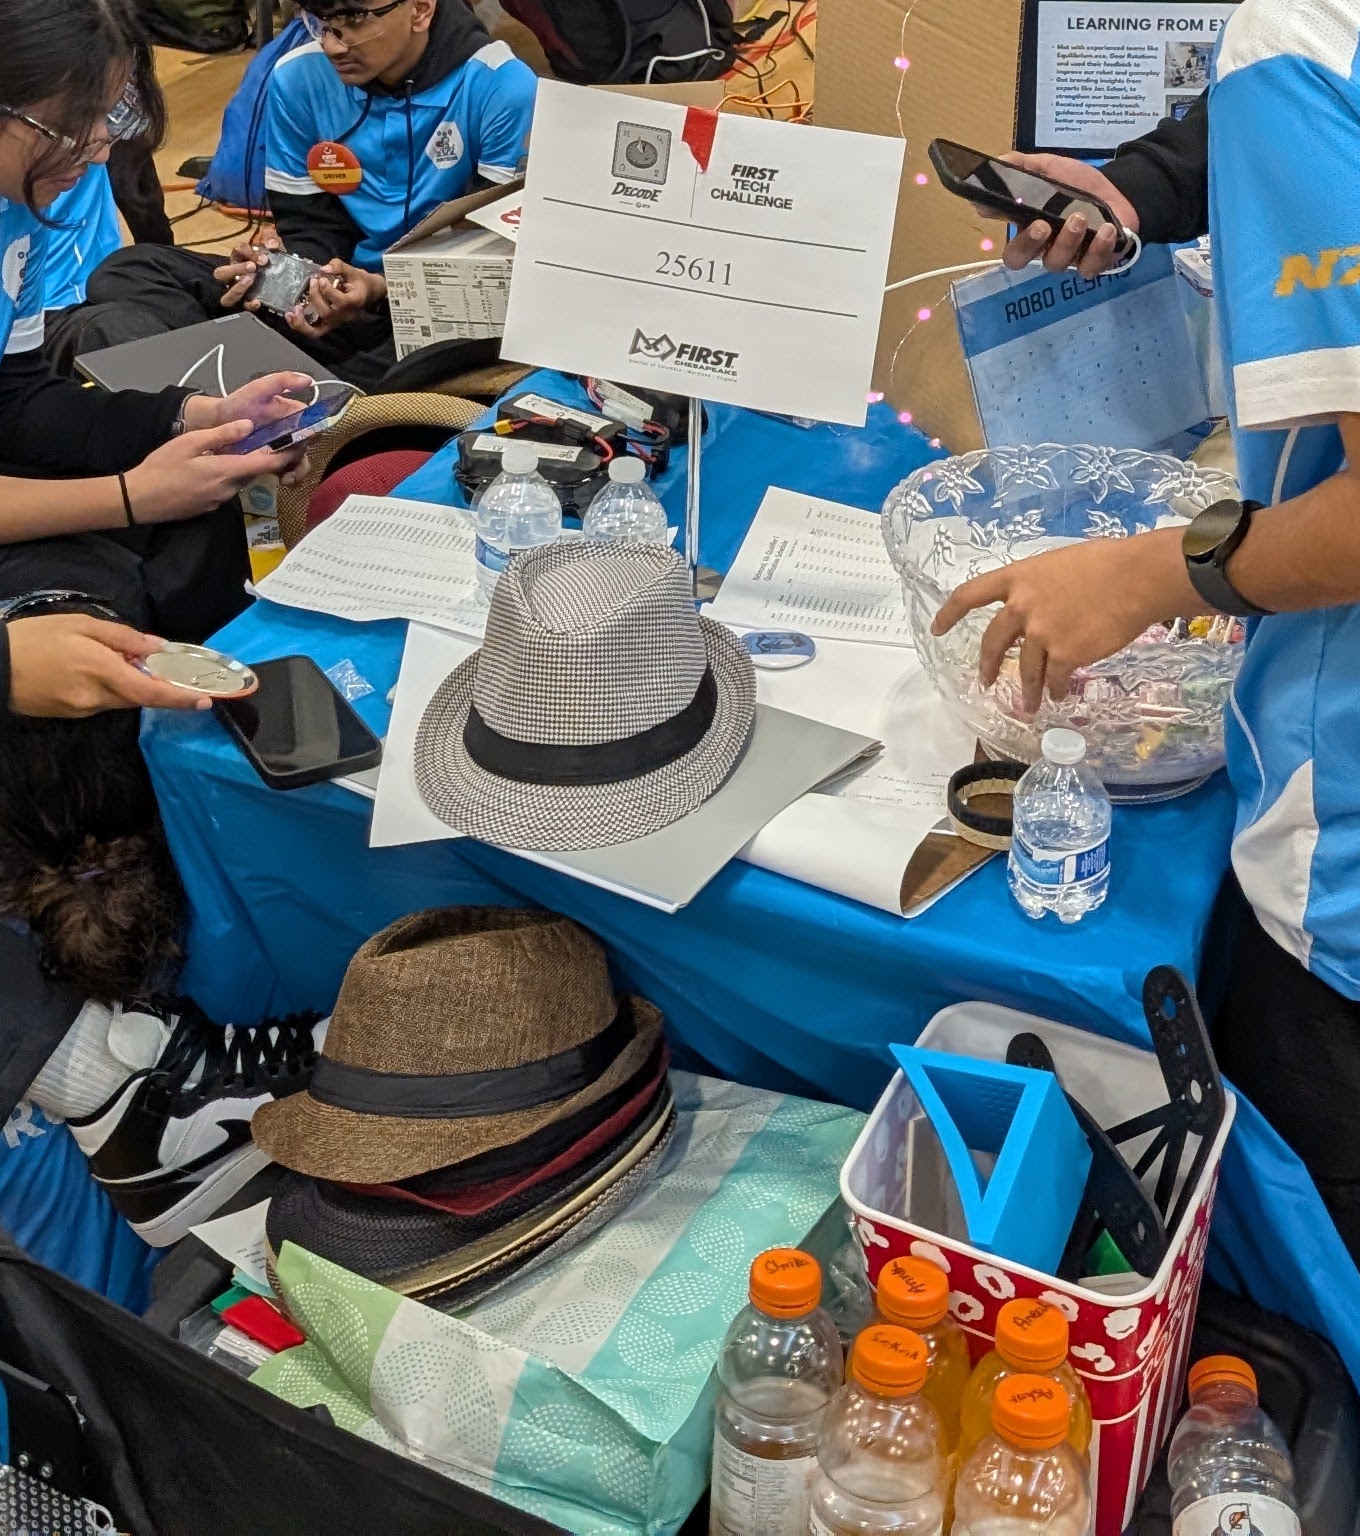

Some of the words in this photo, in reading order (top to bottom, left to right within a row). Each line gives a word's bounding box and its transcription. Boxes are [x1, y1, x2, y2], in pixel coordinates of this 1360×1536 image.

[1067, 17, 1151, 30] LEARNING
[1157, 18, 1203, 31] FROM
[731, 164, 779, 181] FIRST
[611, 182, 662, 202] DECODE
[733, 178, 770, 193] TECH
[711, 188, 793, 210] CHALLENGE
[655, 251, 733, 286] 25611
[1005, 287, 1055, 323] ROBO
[676, 343, 739, 368] FIRST
[674, 360, 737, 376] CHESAPEAKE
